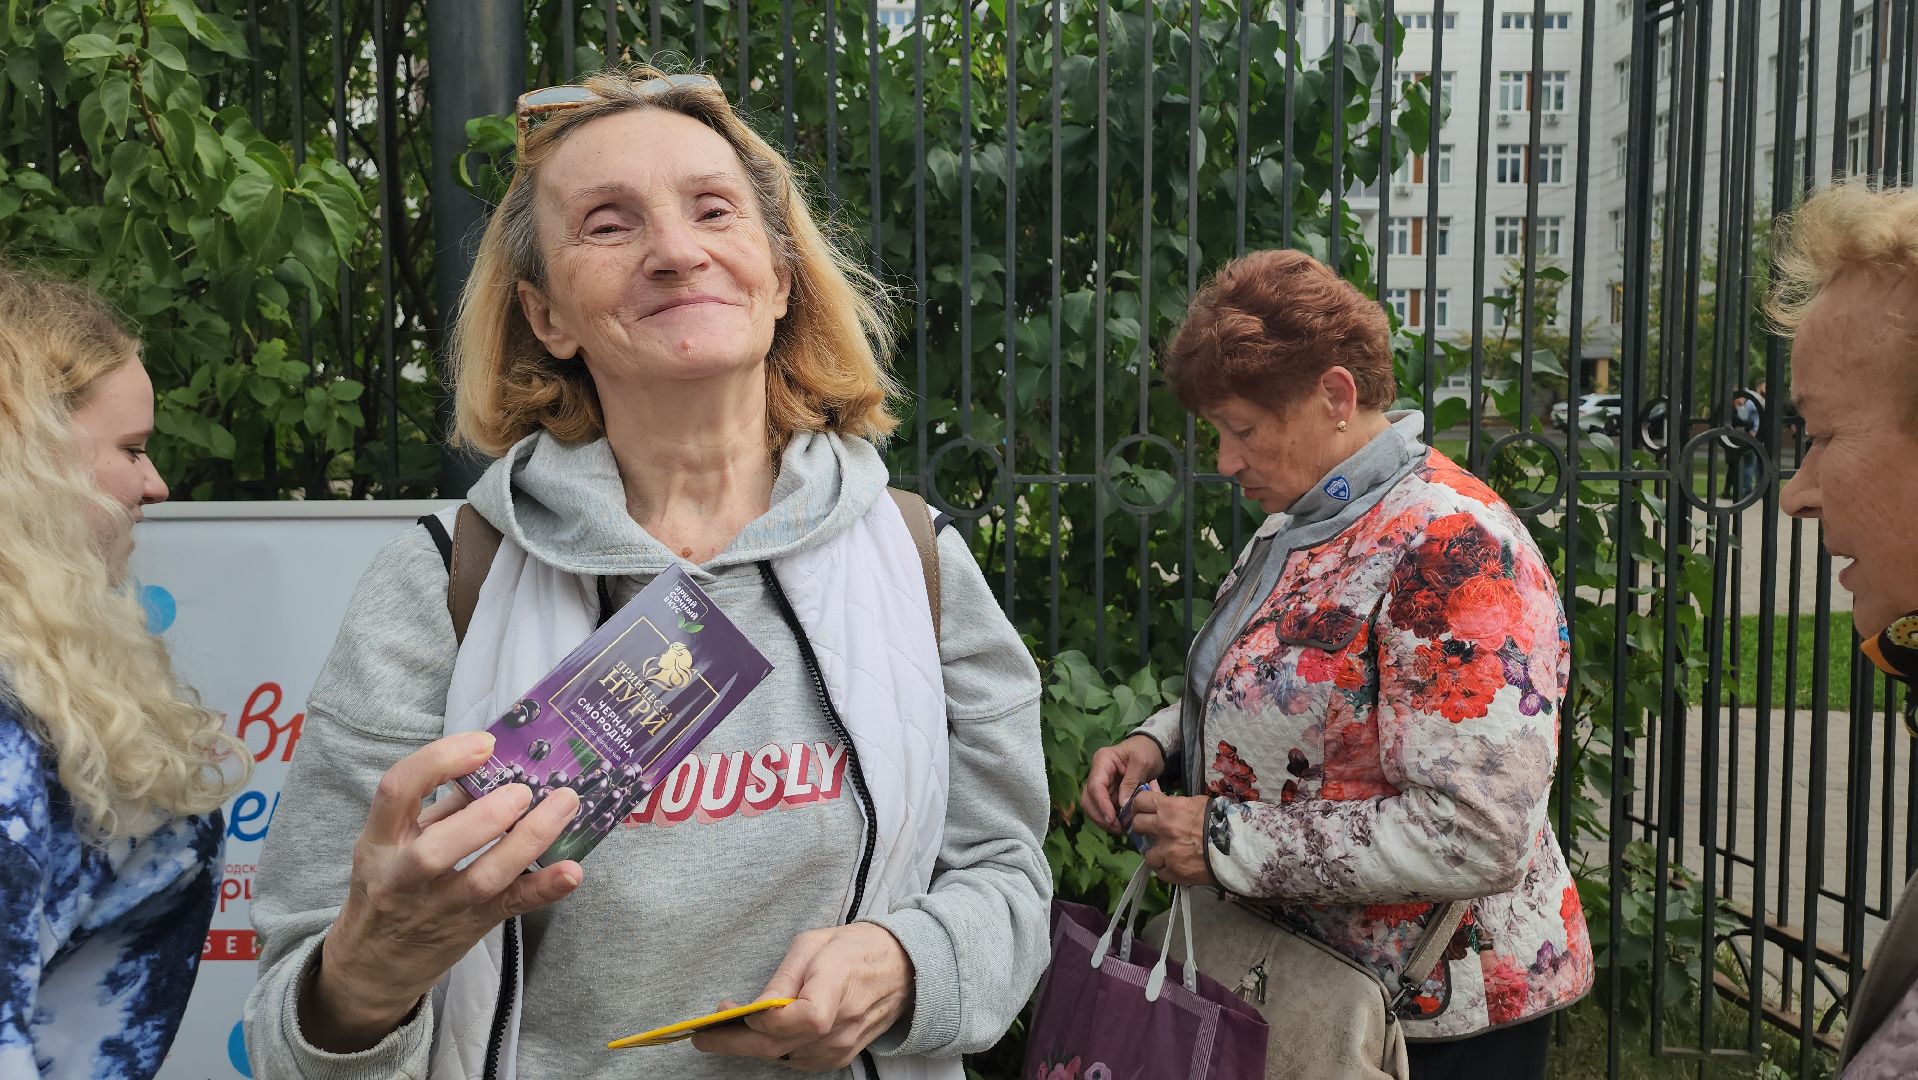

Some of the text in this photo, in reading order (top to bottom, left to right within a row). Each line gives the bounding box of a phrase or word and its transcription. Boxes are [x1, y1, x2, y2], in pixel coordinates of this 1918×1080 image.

[663, 595, 682, 614] ВКУС
[669, 590, 699, 620] СОЧНЫЙ
[674, 585, 698, 608] ЯРКИЙ
[598, 668, 667, 737] НУРИ
[615, 659, 675, 721] ПРИНЦЕССА
[577, 697, 635, 758] СМОРОДИНА
[597, 700, 633, 737] ЧЕРНАЯ
[475, 764, 490, 779] 25
